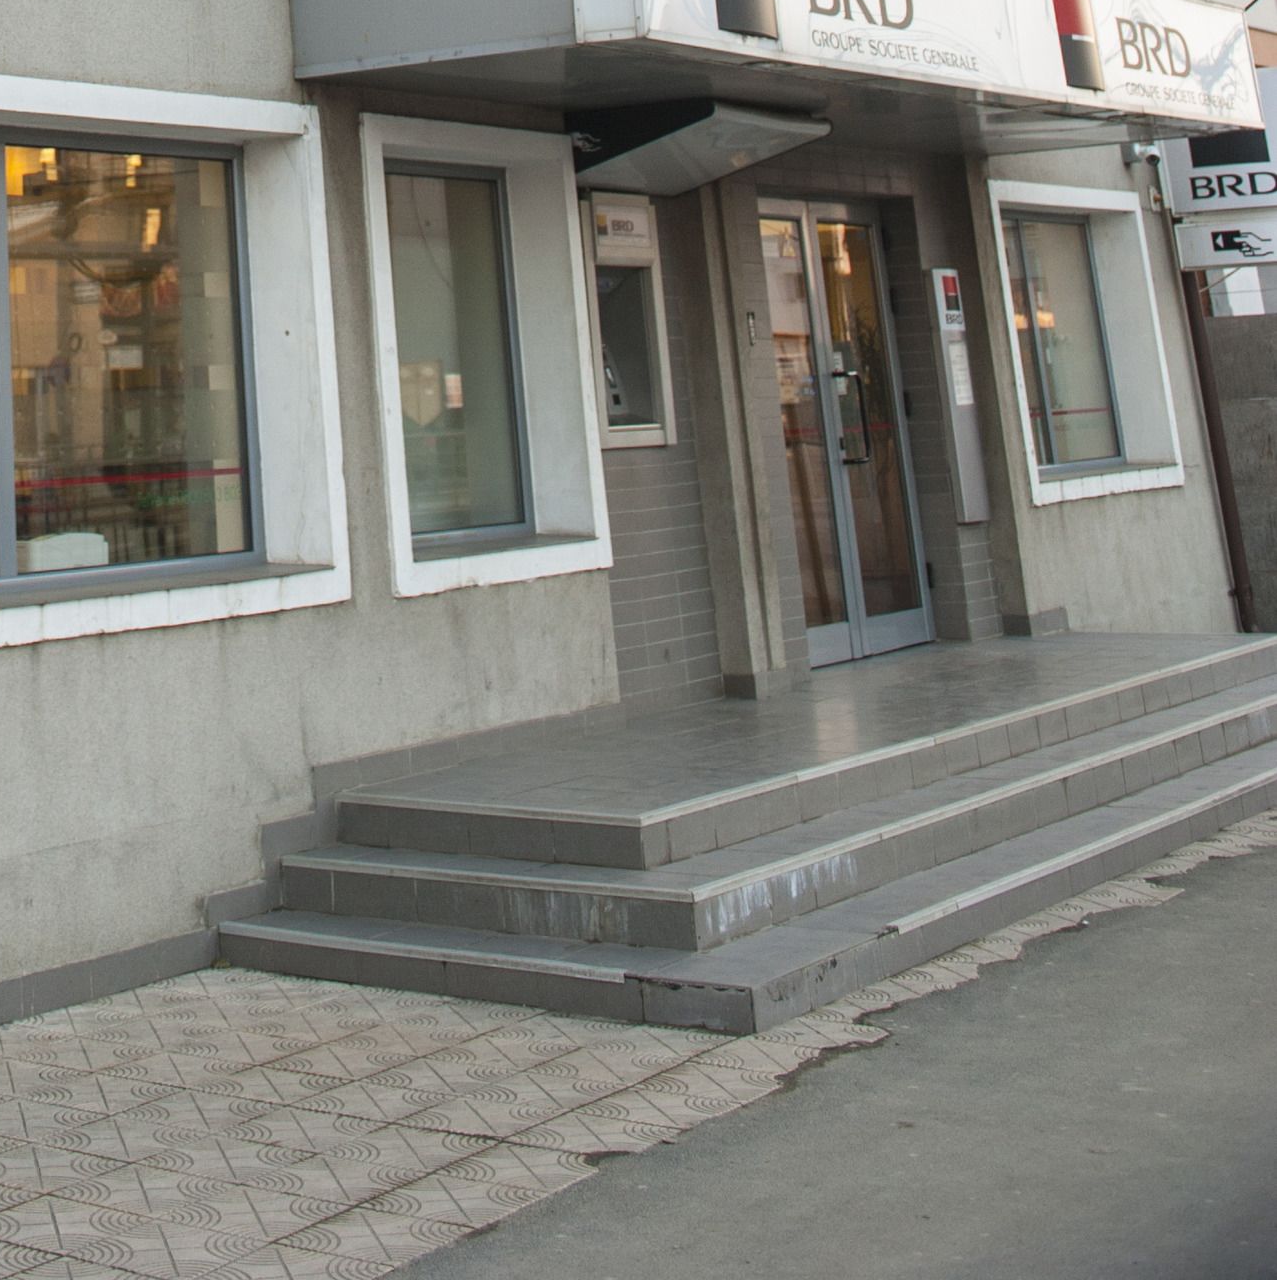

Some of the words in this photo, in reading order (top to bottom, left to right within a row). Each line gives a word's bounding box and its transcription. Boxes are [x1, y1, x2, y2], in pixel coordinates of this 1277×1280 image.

[811, 29, 865, 53] GROUPE
[867, 39, 919, 62] SOCIETE
[922, 48, 980, 72] GENERALE
[1115, 16, 1192, 78] BRD
[1188, 171, 1277, 201] BRD
[611, 219, 634, 233] BRD
